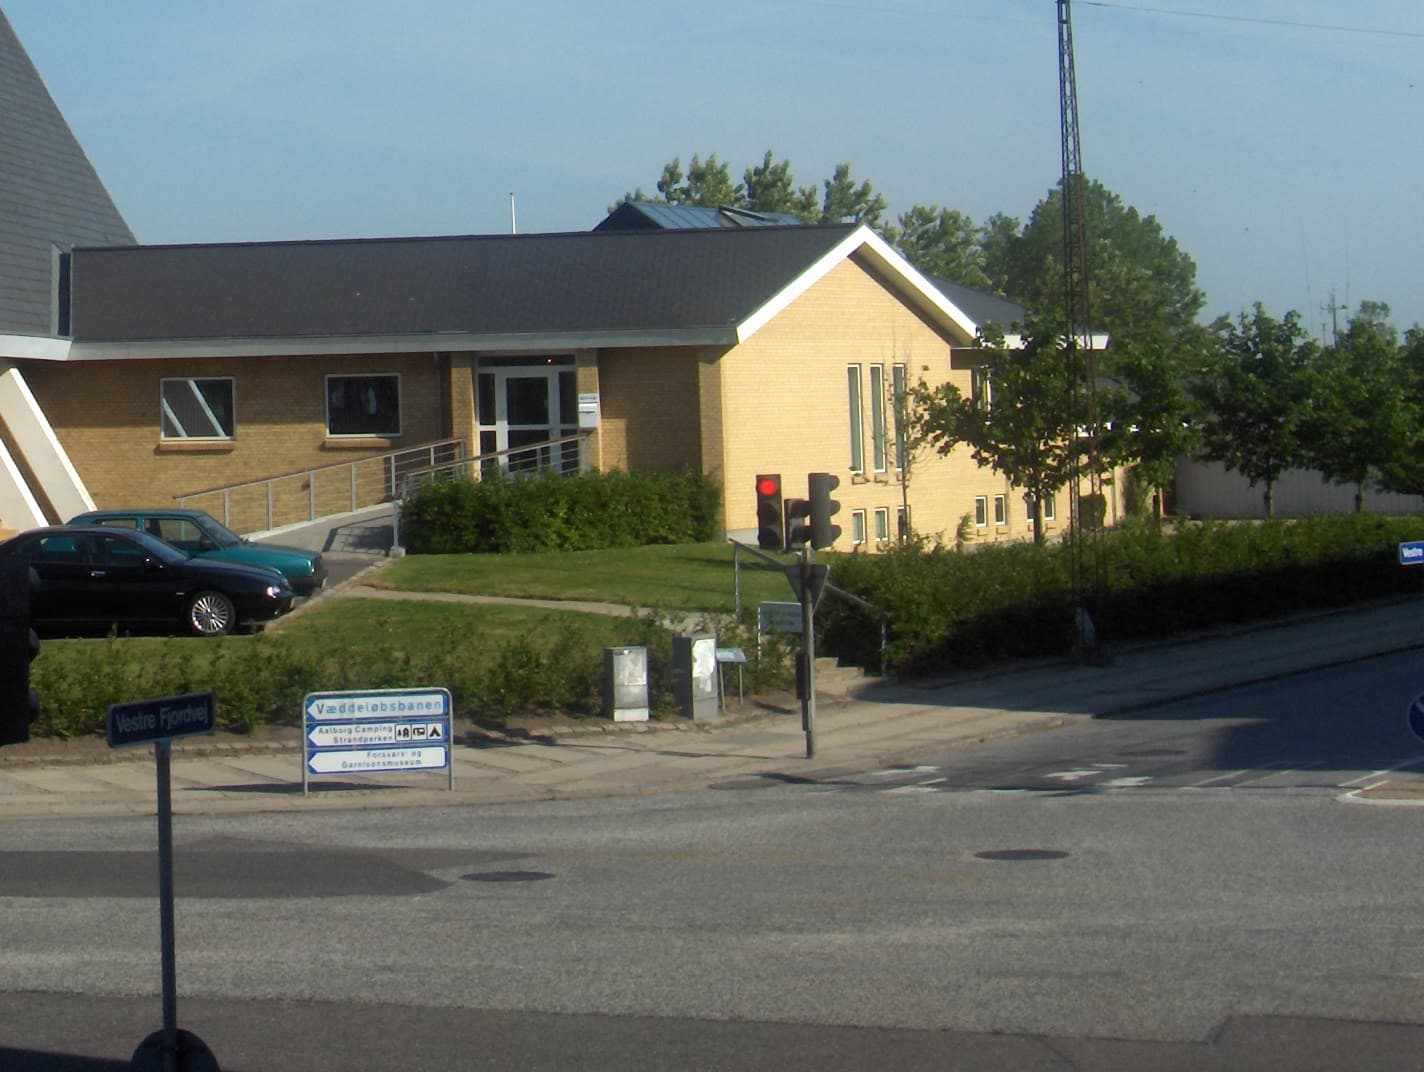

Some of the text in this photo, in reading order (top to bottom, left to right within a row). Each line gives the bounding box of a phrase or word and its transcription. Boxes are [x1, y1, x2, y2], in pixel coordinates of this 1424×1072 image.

[316, 701, 442, 715] Væddeløbsbanen
[115, 703, 208, 733] Vestre Fjordvej
[318, 725, 393, 735] Aalborg Camping
[333, 734, 394, 744] Strandparken
[341, 759, 423, 769] Garnisonsmuseum
